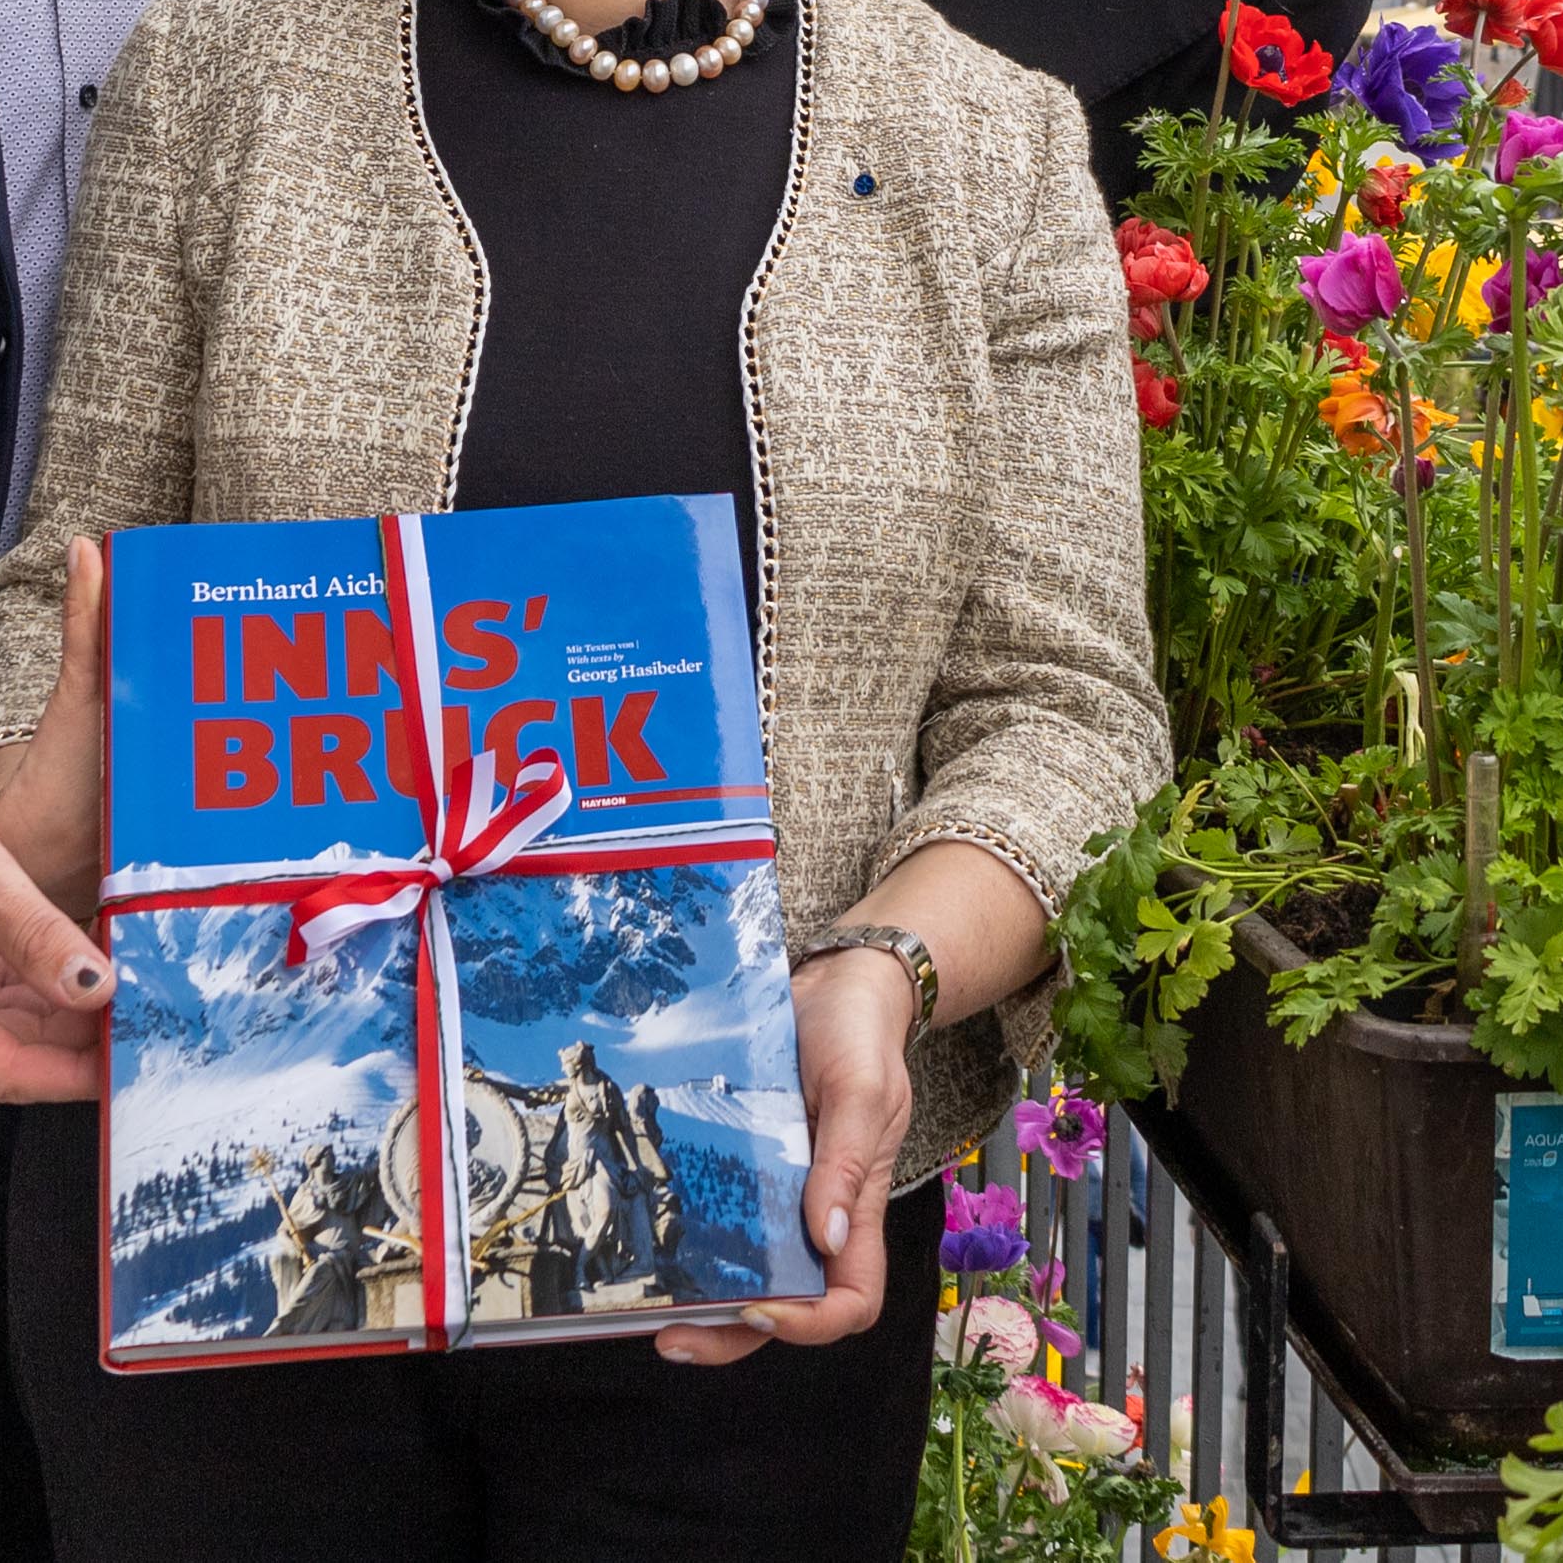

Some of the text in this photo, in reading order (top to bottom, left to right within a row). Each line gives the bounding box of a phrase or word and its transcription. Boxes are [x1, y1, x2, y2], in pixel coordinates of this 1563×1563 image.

[192, 572, 388, 602] Bernhard Aich
[566, 645, 582, 654] Mit
[584, 642, 616, 652] Texten
[567, 652, 625, 665] With texts by
[567, 659, 703, 683] Georg Hasibeder
[193, 690, 668, 811] BRUCK
[581, 796, 626, 809] HAYMON
